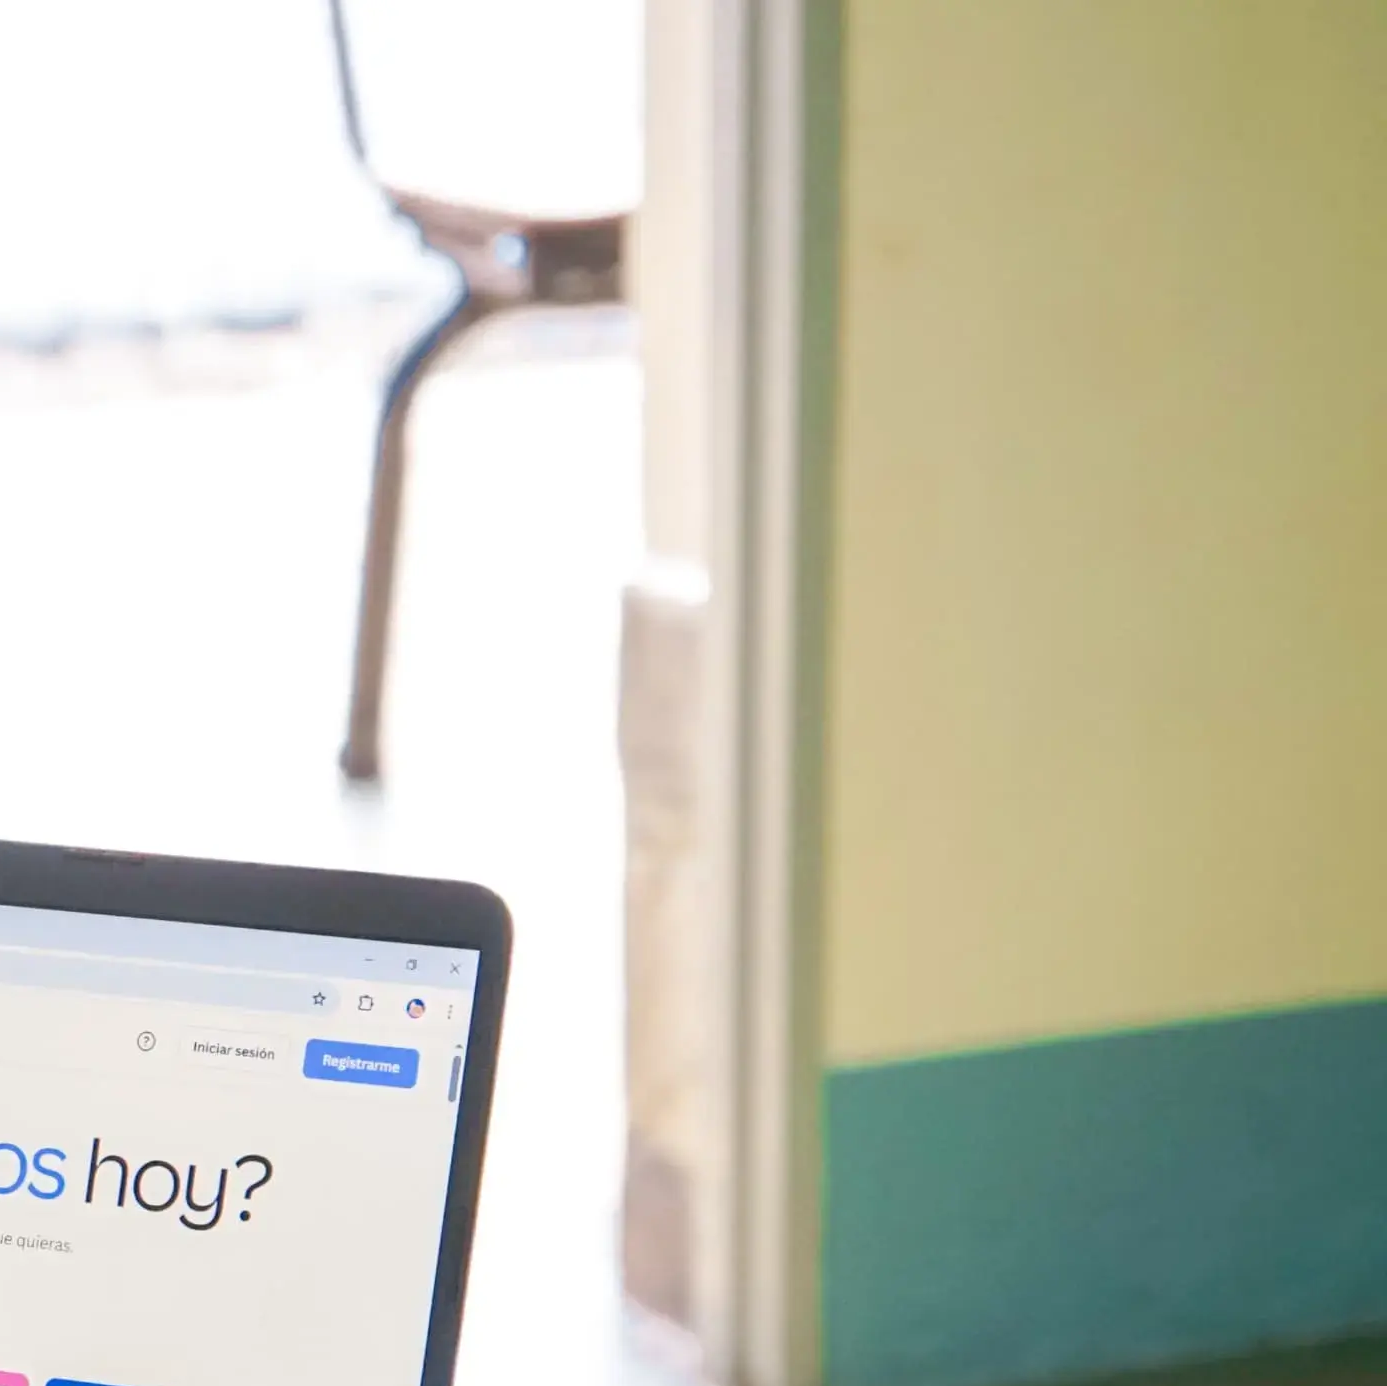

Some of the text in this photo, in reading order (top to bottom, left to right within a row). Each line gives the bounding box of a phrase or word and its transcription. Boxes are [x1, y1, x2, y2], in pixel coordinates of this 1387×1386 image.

[193, 1040, 276, 1061] Iniciar sesión
[322, 1053, 401, 1074] Registrarme
[84, 1137, 275, 1231] hoy?
[16, 1235, 74, 1253] quieras.
